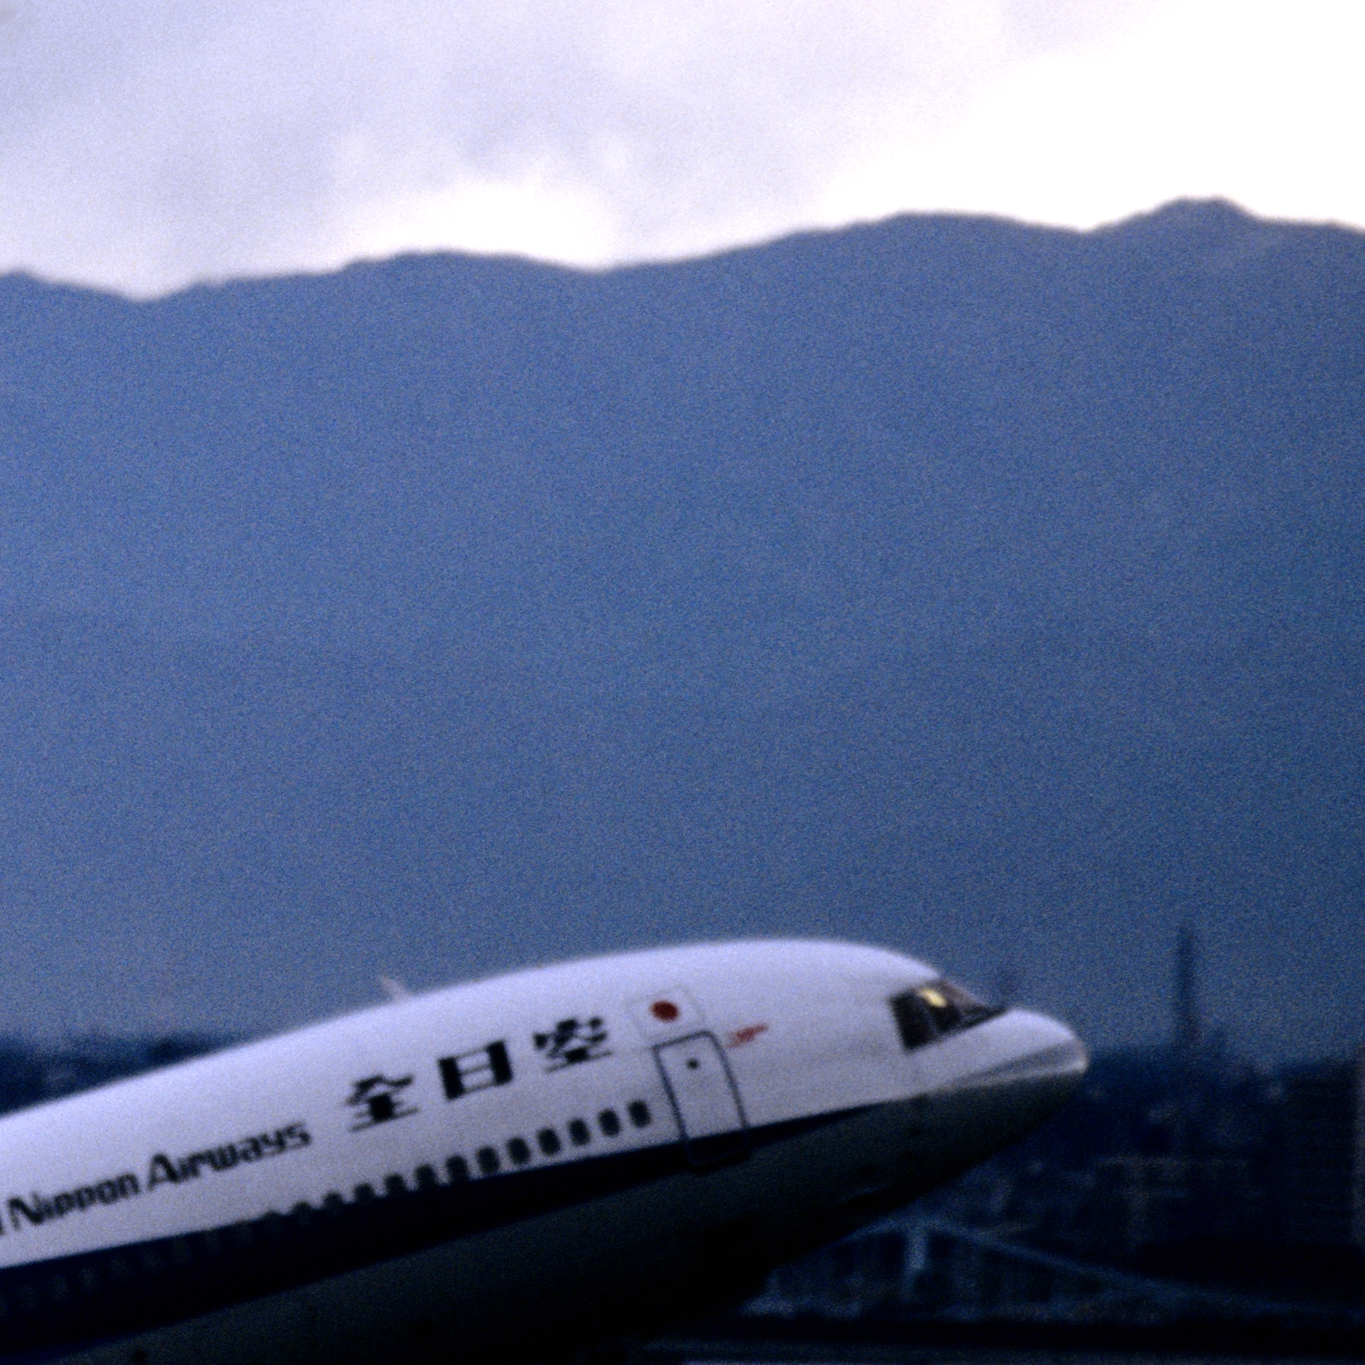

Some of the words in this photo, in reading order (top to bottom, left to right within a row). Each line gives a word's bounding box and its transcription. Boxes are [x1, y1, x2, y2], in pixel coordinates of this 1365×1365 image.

[345, 1016, 612, 1132] 全日空
[6, 1191, 140, 1231] Nippon
[146, 1121, 312, 1191] Airways
